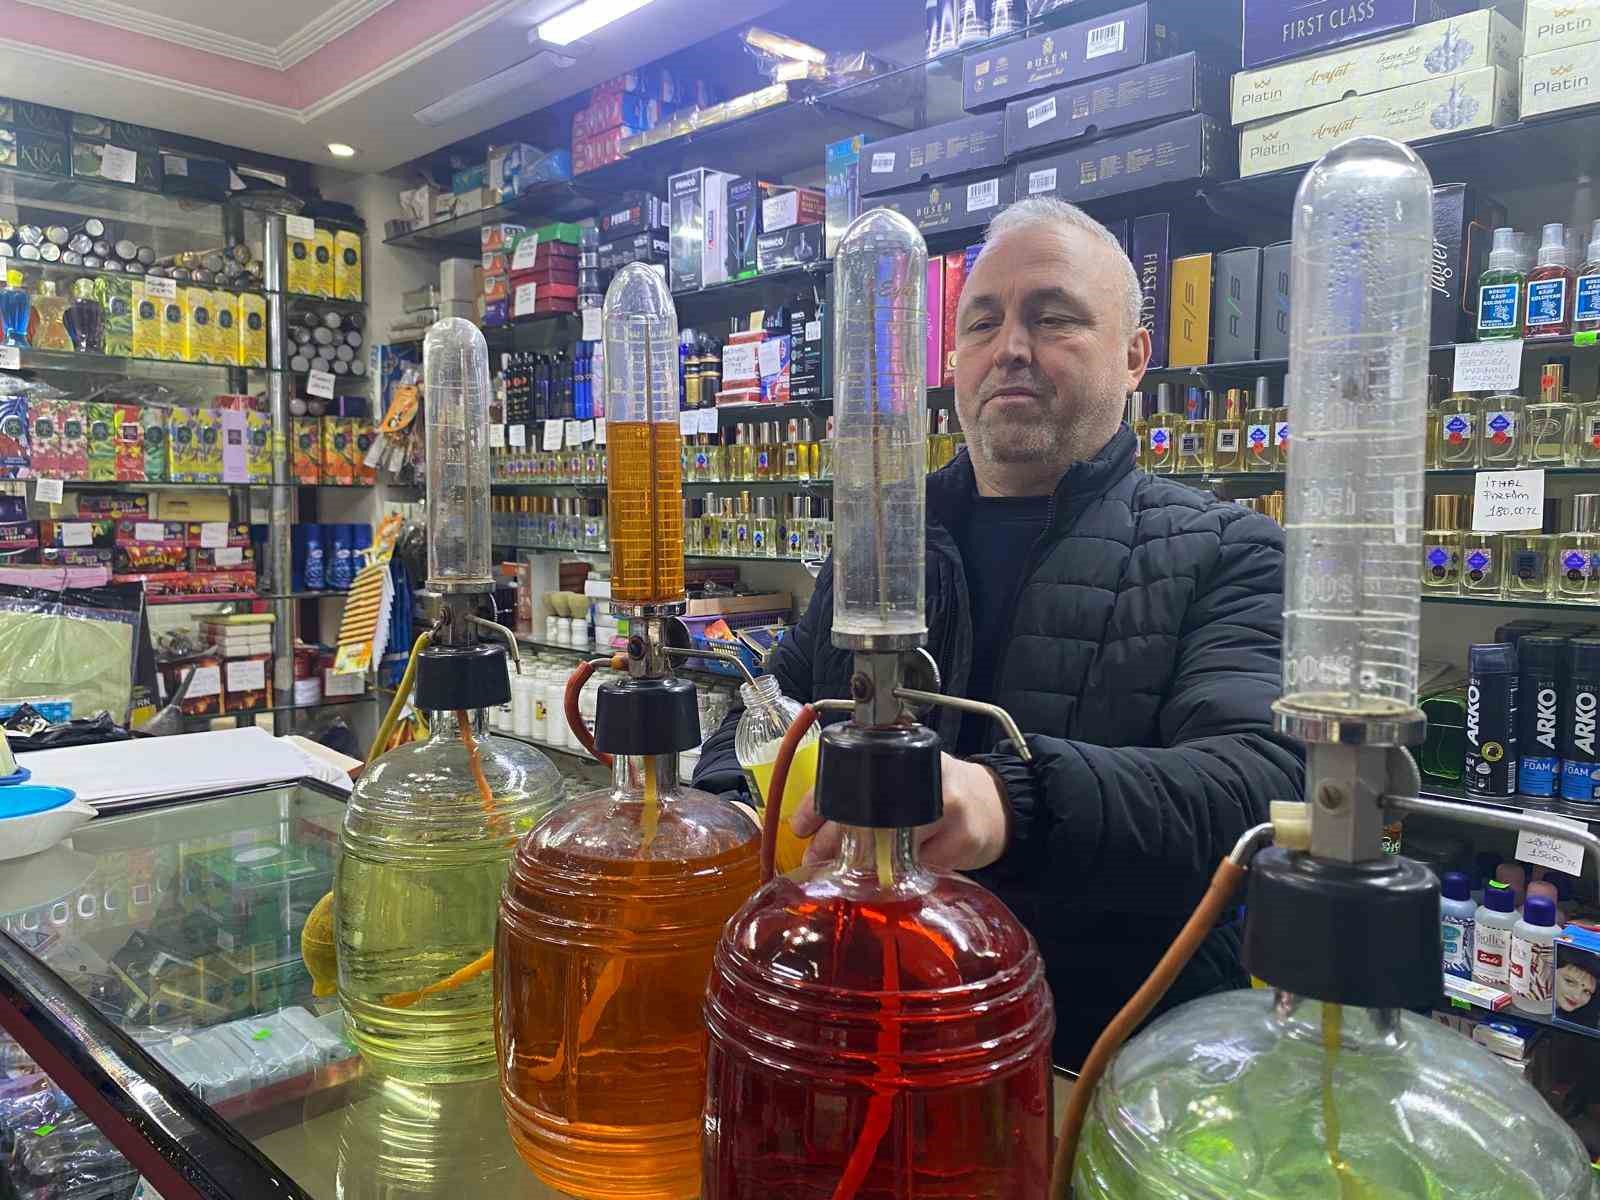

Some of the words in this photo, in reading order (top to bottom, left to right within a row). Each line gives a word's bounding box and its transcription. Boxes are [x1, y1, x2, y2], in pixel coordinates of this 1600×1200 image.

[1282, 14, 1324, 43] FIRST
[1329, 0, 1376, 29] CLASS
[1537, 15, 1592, 38] Platin
[1242, 88, 1282, 105] Platin
[1533, 76, 1589, 96] Platin
[1250, 142, 1290, 160] Platin
[1143, 253, 1158, 291] FIRST
[1467, 685, 1481, 747] ARKO
[1536, 688, 1557, 750] ARKO
[1574, 692, 1598, 756] ARKO
[1523, 761, 1551, 771] FOAM
[1564, 764, 1589, 777] FOAM
